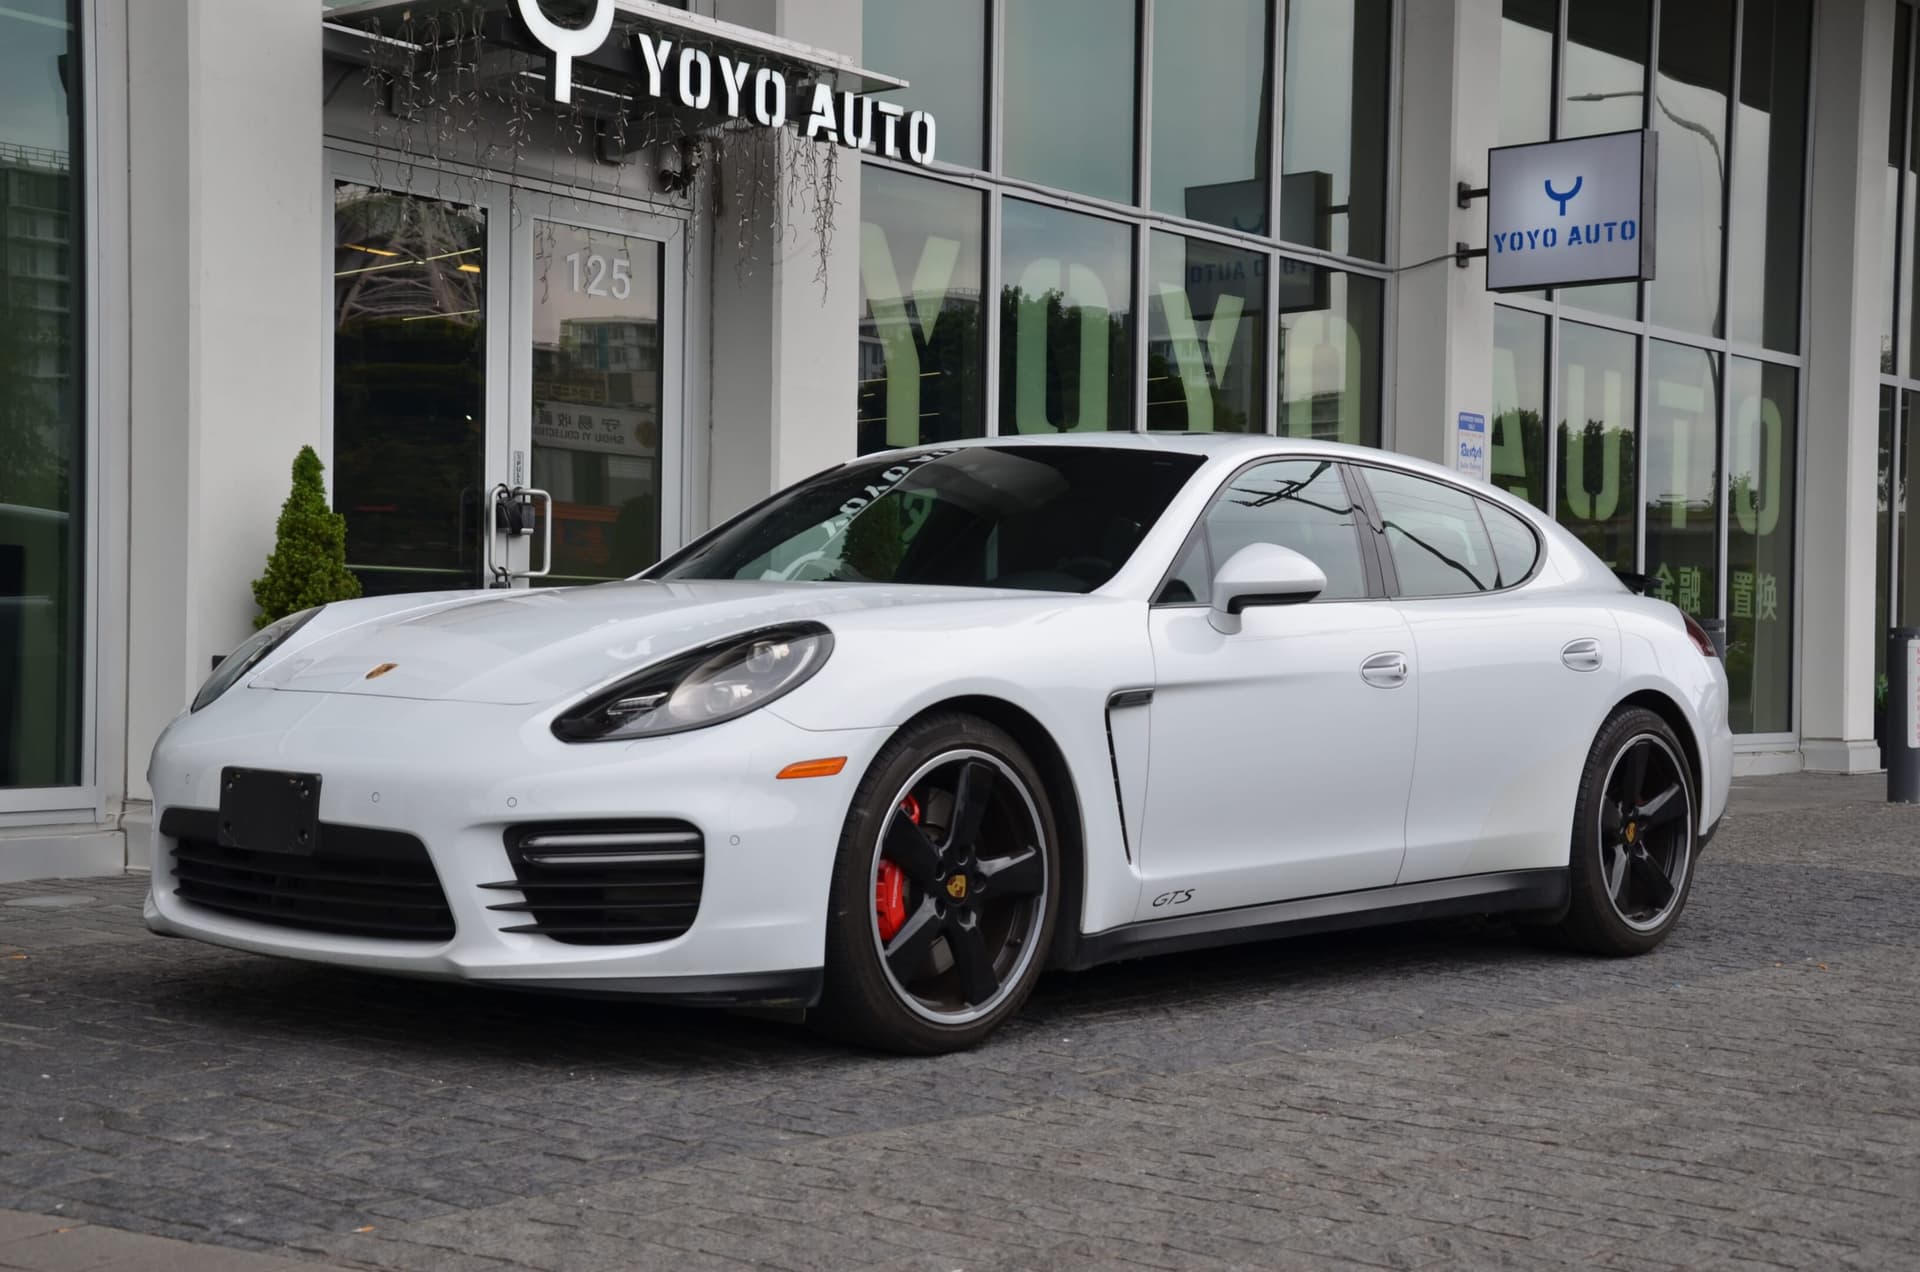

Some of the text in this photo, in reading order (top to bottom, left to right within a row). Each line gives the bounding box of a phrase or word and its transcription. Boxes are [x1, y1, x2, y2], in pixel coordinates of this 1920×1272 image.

[638, 32, 936, 165] YOYO AUTO
[1493, 219, 1636, 254] YOYO AUTO
[566, 252, 631, 300] 125
[861, 222, 1361, 446] YOYO
[1732, 570, 1778, 622] 置换
[1152, 888, 1196, 907] GTS
